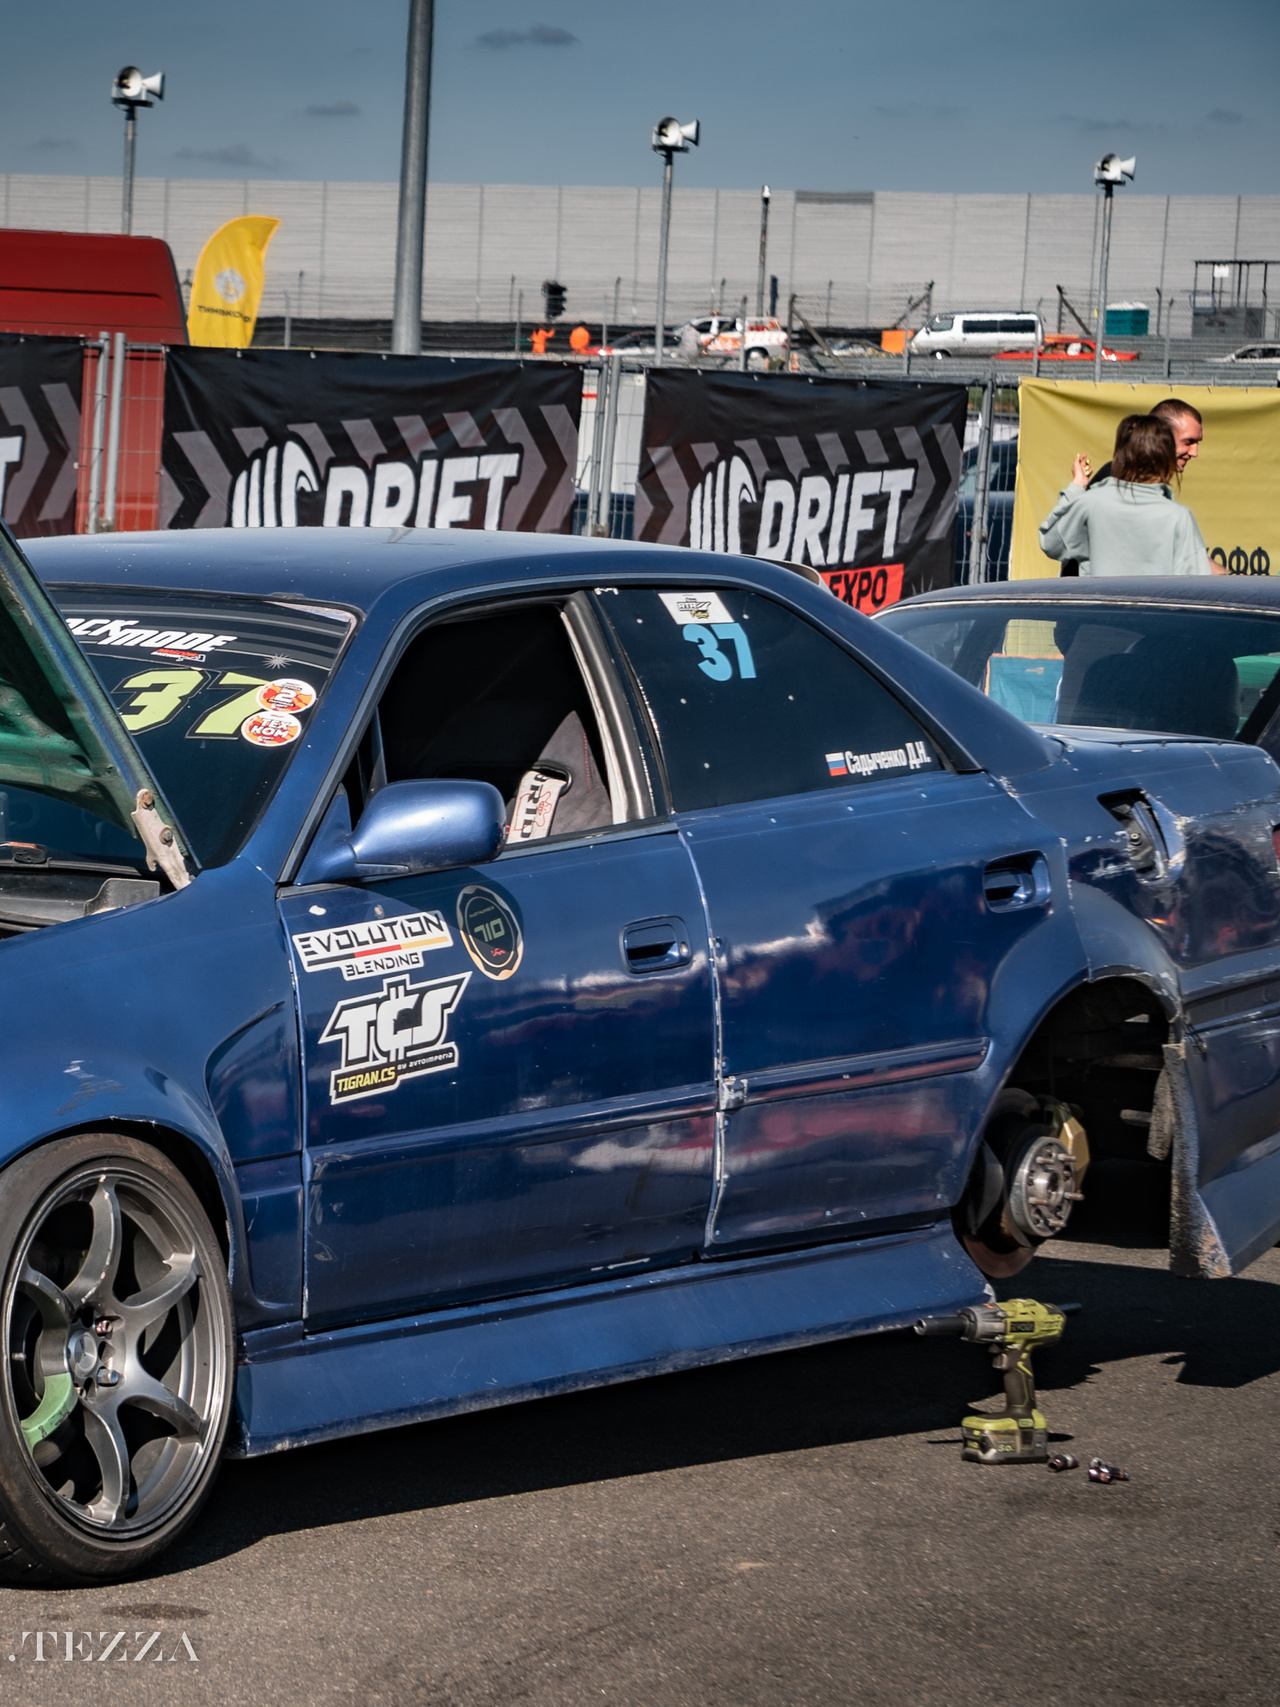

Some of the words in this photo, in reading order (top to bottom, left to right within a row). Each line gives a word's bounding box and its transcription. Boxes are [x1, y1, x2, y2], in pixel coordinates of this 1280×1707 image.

[323, 453, 520, 531] DRIFT
[756, 468, 915, 566] DRIFT
[829, 569, 889, 608] EXPO
[682, 623, 757, 682] 37
[117, 669, 272, 736] 37
[274, 688, 297, 703] 2
[844, 750, 908, 777] Садыченко
[297, 912, 445, 958] EVOLUTION
[346, 952, 420, 978] BLENDING
[336, 1066, 397, 1093] TIGRAN.CS
